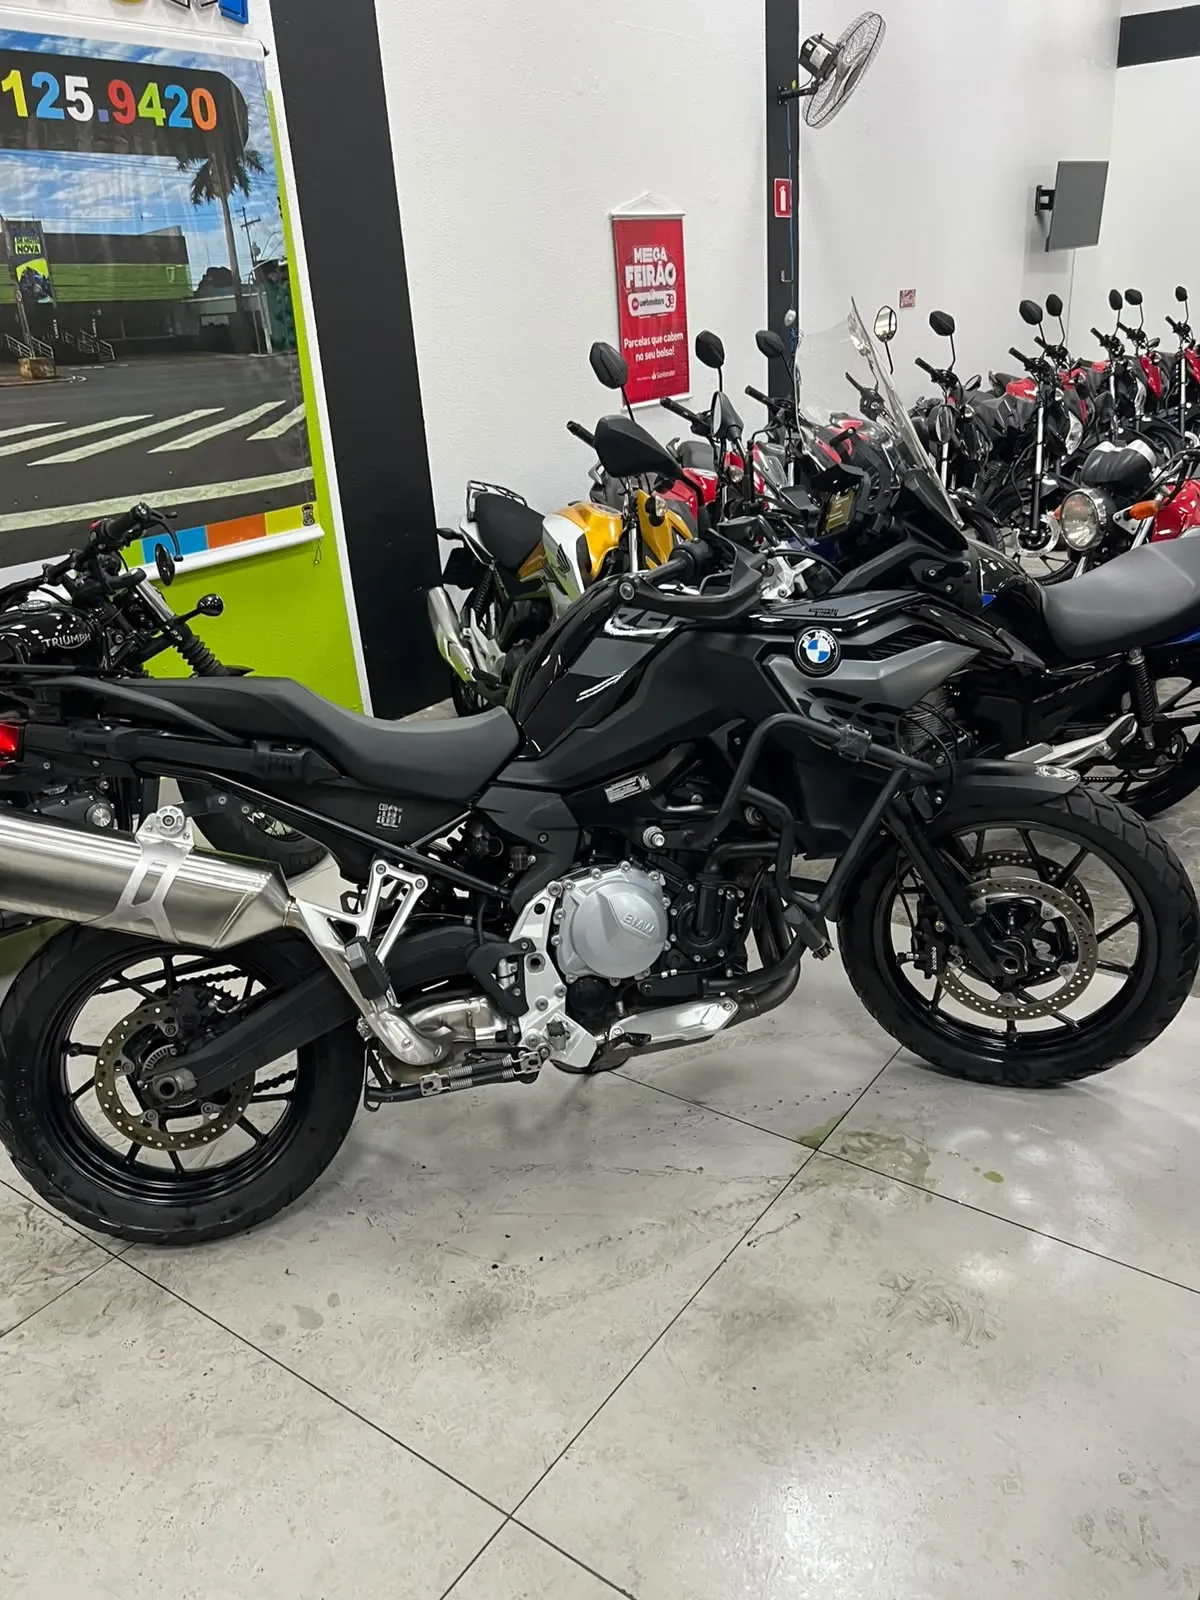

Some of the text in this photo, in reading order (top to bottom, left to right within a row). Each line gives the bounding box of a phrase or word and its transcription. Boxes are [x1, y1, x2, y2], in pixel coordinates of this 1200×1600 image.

[1, 69, 217, 132] 125.9420
[16, 244, 40, 253] NOVA
[633, 246, 668, 263] MEGA
[624, 260, 677, 289] FEIRÃO
[624, 331, 684, 349] Parcelas que cabem
[635, 344, 675, 362] no seu bolso!
[41, 632, 92, 648] TRIUMPH
[801, 631, 835, 649] BMW
[623, 913, 655, 934] BMW
